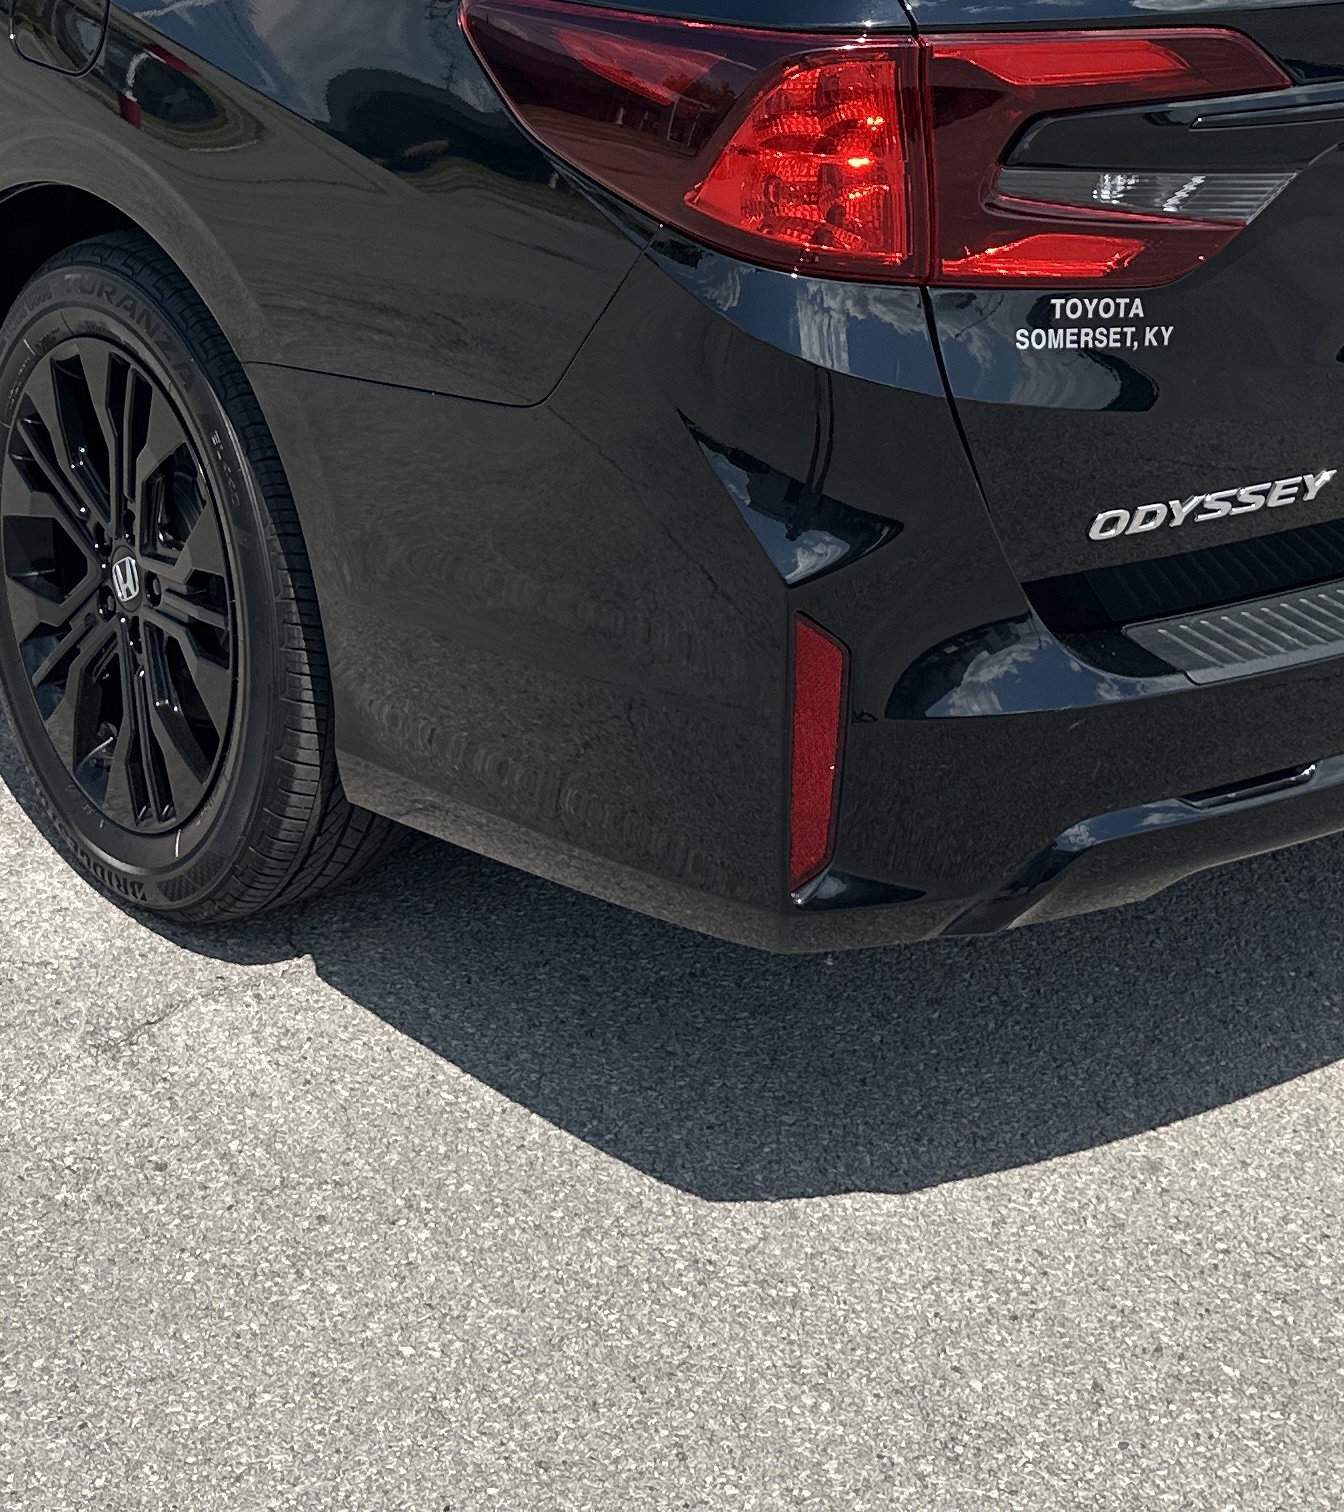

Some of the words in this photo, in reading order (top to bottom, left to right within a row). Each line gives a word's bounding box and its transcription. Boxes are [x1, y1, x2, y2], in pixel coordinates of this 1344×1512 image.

[1050, 297, 1144, 319] TOYOTA
[1016, 326, 1138, 351] SOMERSET,
[1144, 326, 1174, 347] KY
[1088, 469, 1338, 541] ODYSSEY
